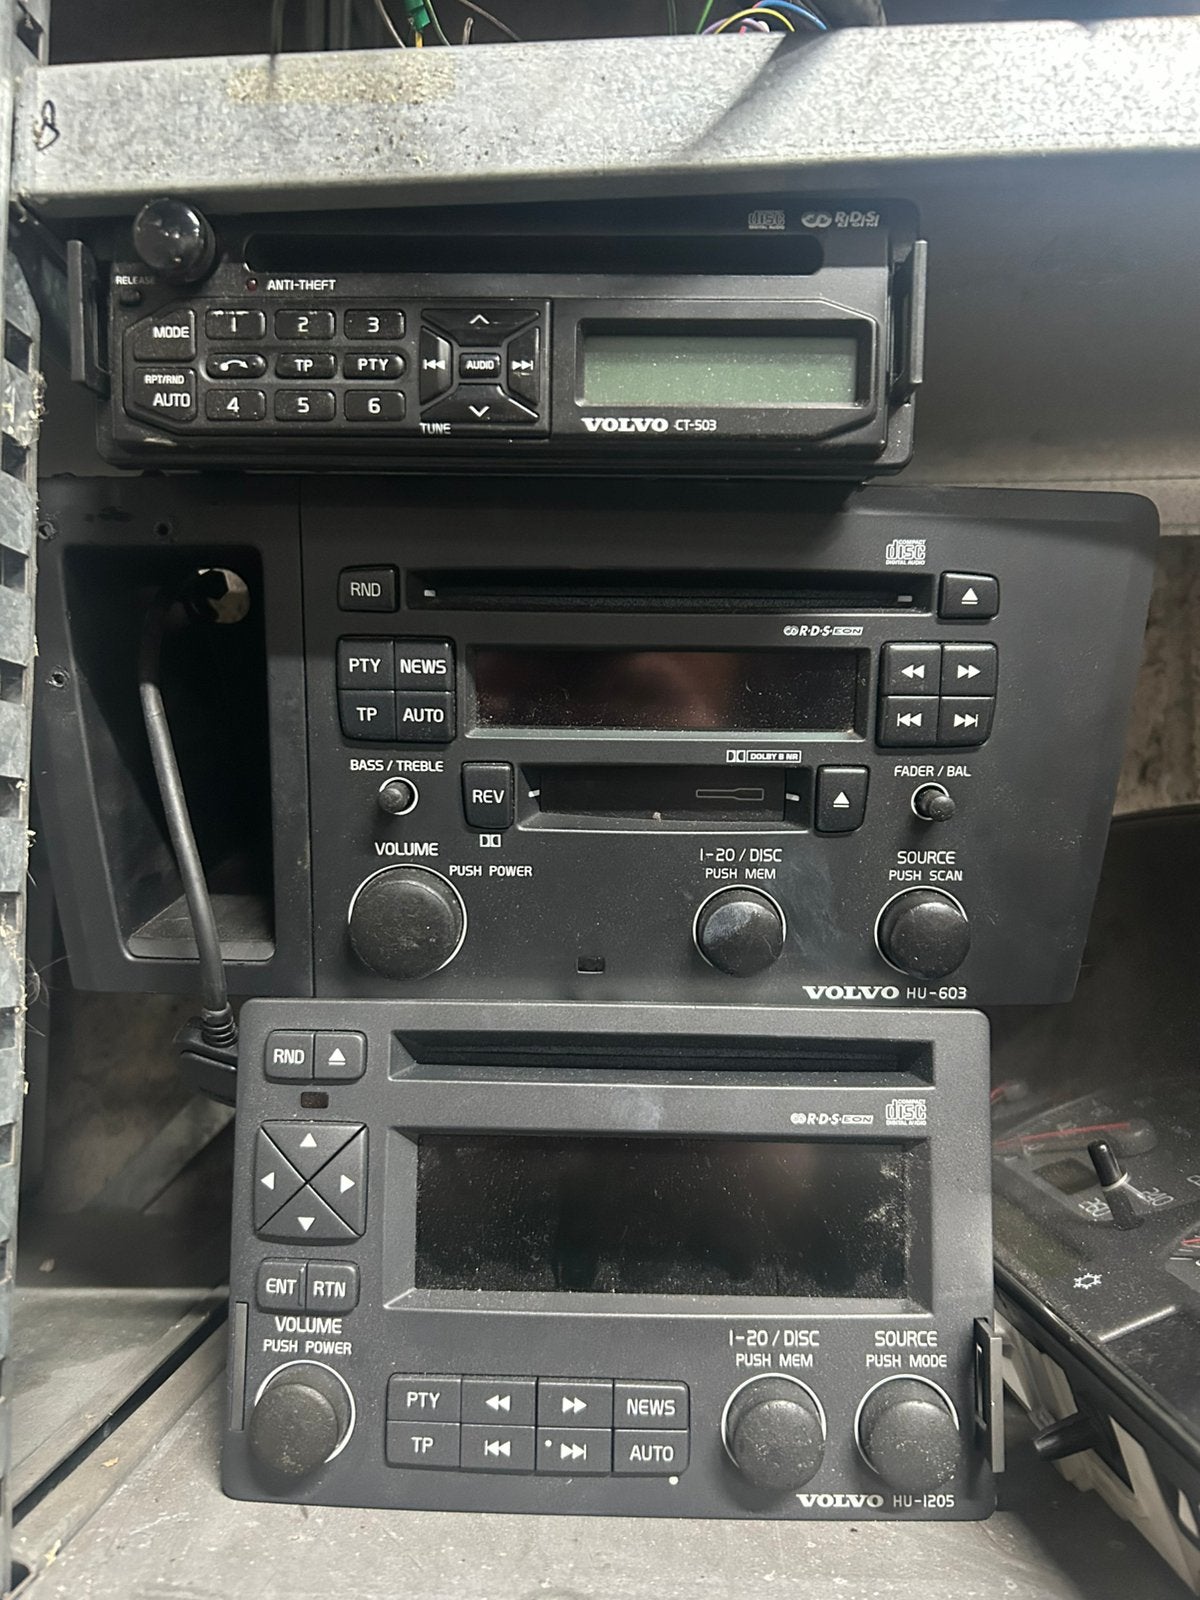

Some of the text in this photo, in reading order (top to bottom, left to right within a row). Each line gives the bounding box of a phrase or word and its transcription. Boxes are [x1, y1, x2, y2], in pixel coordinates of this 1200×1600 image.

[267, 280, 336, 290] ANTI-THEFT
[231, 317, 236, 332] 1
[298, 317, 308, 332] 2
[368, 317, 379, 332] 3
[153, 326, 190, 338] MODE
[295, 359, 313, 371] TP
[358, 358, 388, 371] PTY
[466, 361, 494, 371] AUDIO
[144, 375, 184, 384] RPT/RND
[153, 393, 190, 407] AUTO
[227, 397, 239, 412] 4
[298, 397, 309, 412] 5
[368, 398, 380, 413] 6
[419, 423, 450, 434] TUNE
[581, 418, 716, 432] VOLVO CT-503
[351, 582, 380, 596] RND
[349, 658, 380, 672] PTY
[401, 659, 446, 674] NEWS
[356, 708, 377, 721] TP
[403, 708, 443, 722] AUTO
[749, 753, 799, 761] DOLBY B NR
[350, 759, 384, 771] BASS
[396, 760, 443, 772] TREBLE
[894, 766, 934, 776] FADER
[947, 766, 971, 776] BAL
[473, 790, 504, 803] REV
[375, 842, 438, 856] VOLUME
[750, 849, 782, 862] DISC
[898, 851, 955, 864] SOURCE
[450, 865, 532, 876] PUSH POWER
[706, 868, 775, 879] PUSH MEM
[889, 870, 962, 881] PUSH SCAN
[802, 986, 966, 999] VOLVO HU-603
[274, 1049, 304, 1064] RND
[266, 1278, 297, 1294] ENT
[313, 1281, 345, 1297] RTN
[275, 1316, 342, 1334] VOLUME
[784, 1330, 819, 1347] DISC
[875, 1331, 937, 1347] SOURCE
[263, 1339, 351, 1355] PUSH POWER
[736, 1353, 813, 1367] PUSH MEM
[866, 1354, 947, 1367] PUSH MODE
[407, 1392, 440, 1408] PTY
[627, 1399, 675, 1416] NEWS
[411, 1437, 433, 1453] TP
[630, 1445, 673, 1461] AUTO
[796, 1494, 954, 1507] VOLVO HU-1205
